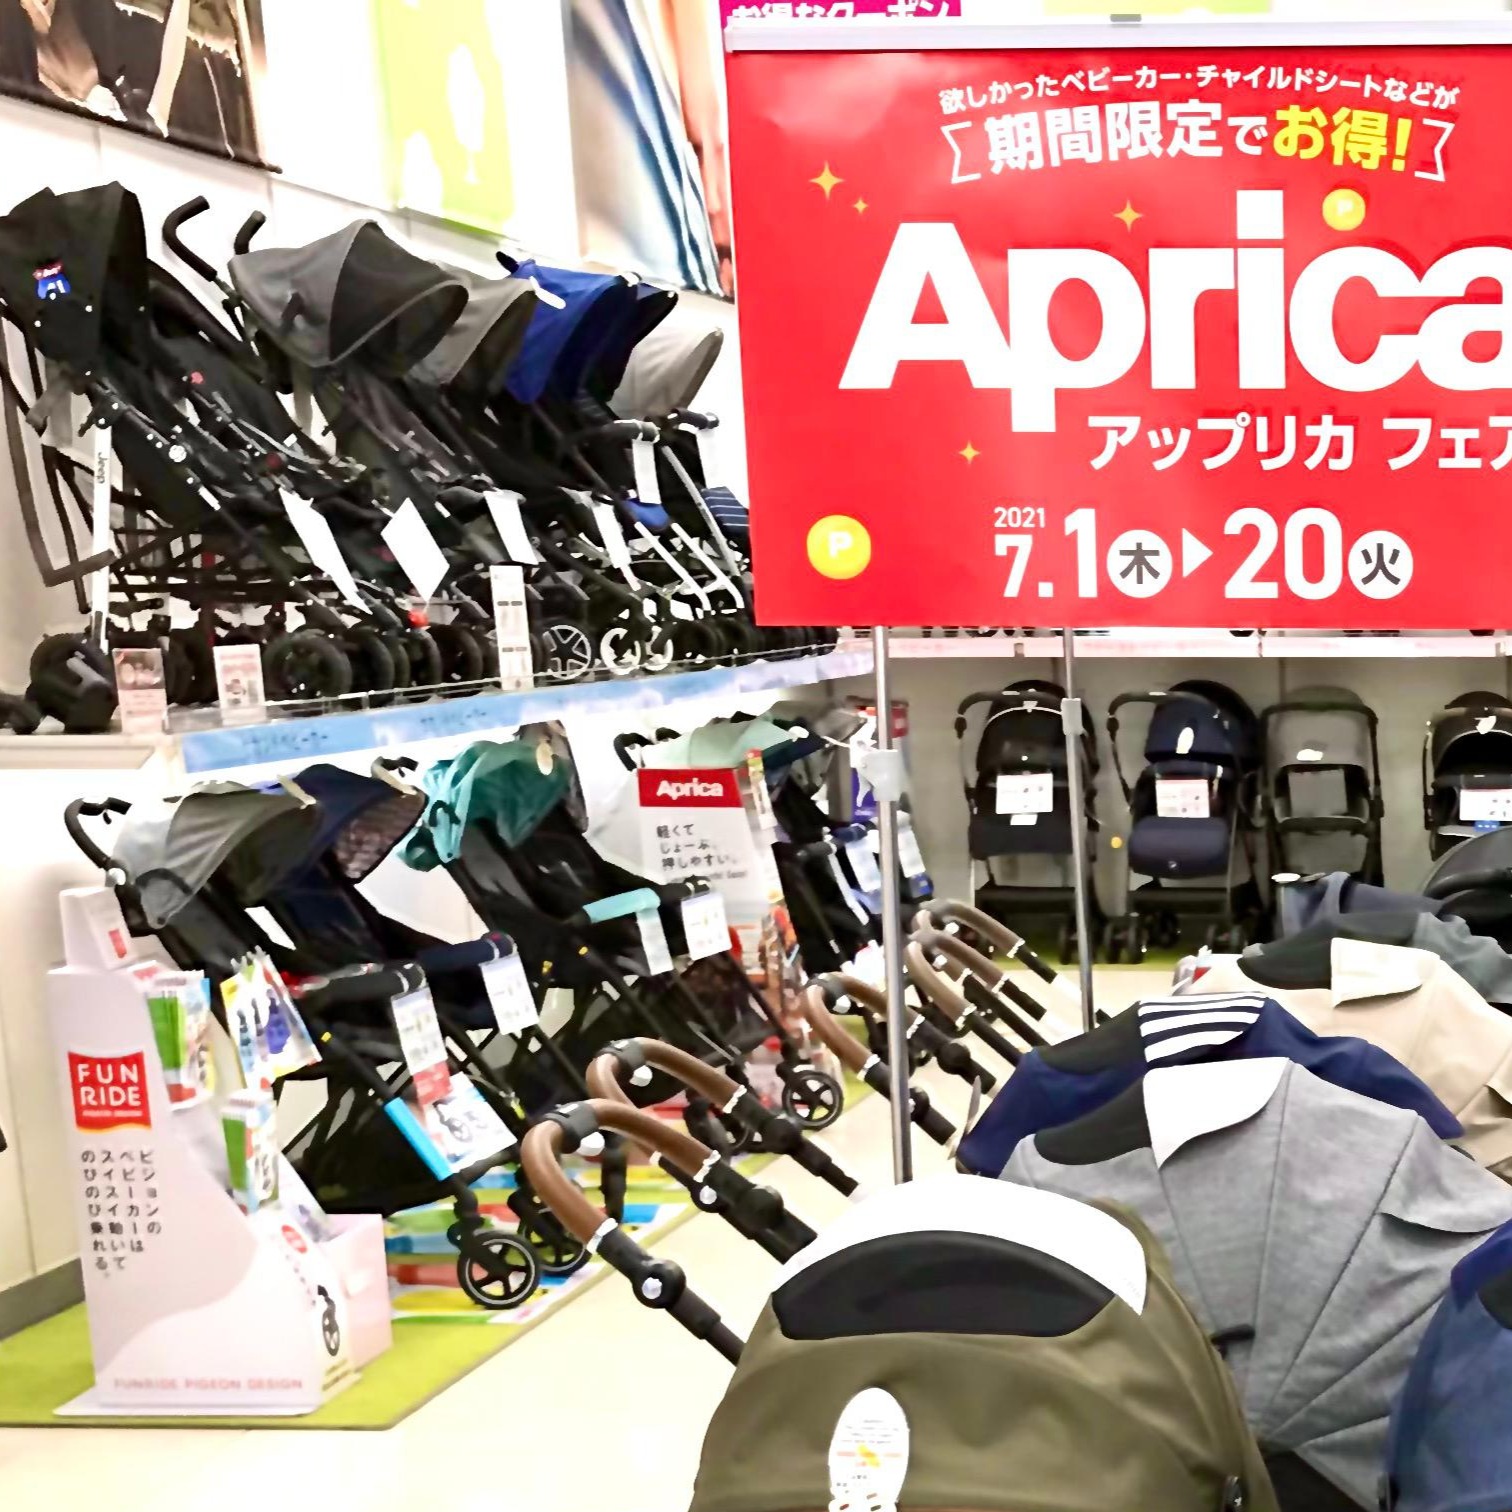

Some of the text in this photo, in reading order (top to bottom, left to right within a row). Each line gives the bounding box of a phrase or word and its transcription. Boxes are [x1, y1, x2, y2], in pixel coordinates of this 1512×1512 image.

[938, 65, 1460, 114] 欲しかったベビーカー・チャイルドシートなどが
[1088, 413, 1355, 472] アップリカ
[994, 507, 1046, 529] 2021
[656, 777, 724, 801] Aprica
[77, 1063, 139, 1085] FUN
[80, 1086, 142, 1107] RIDE
